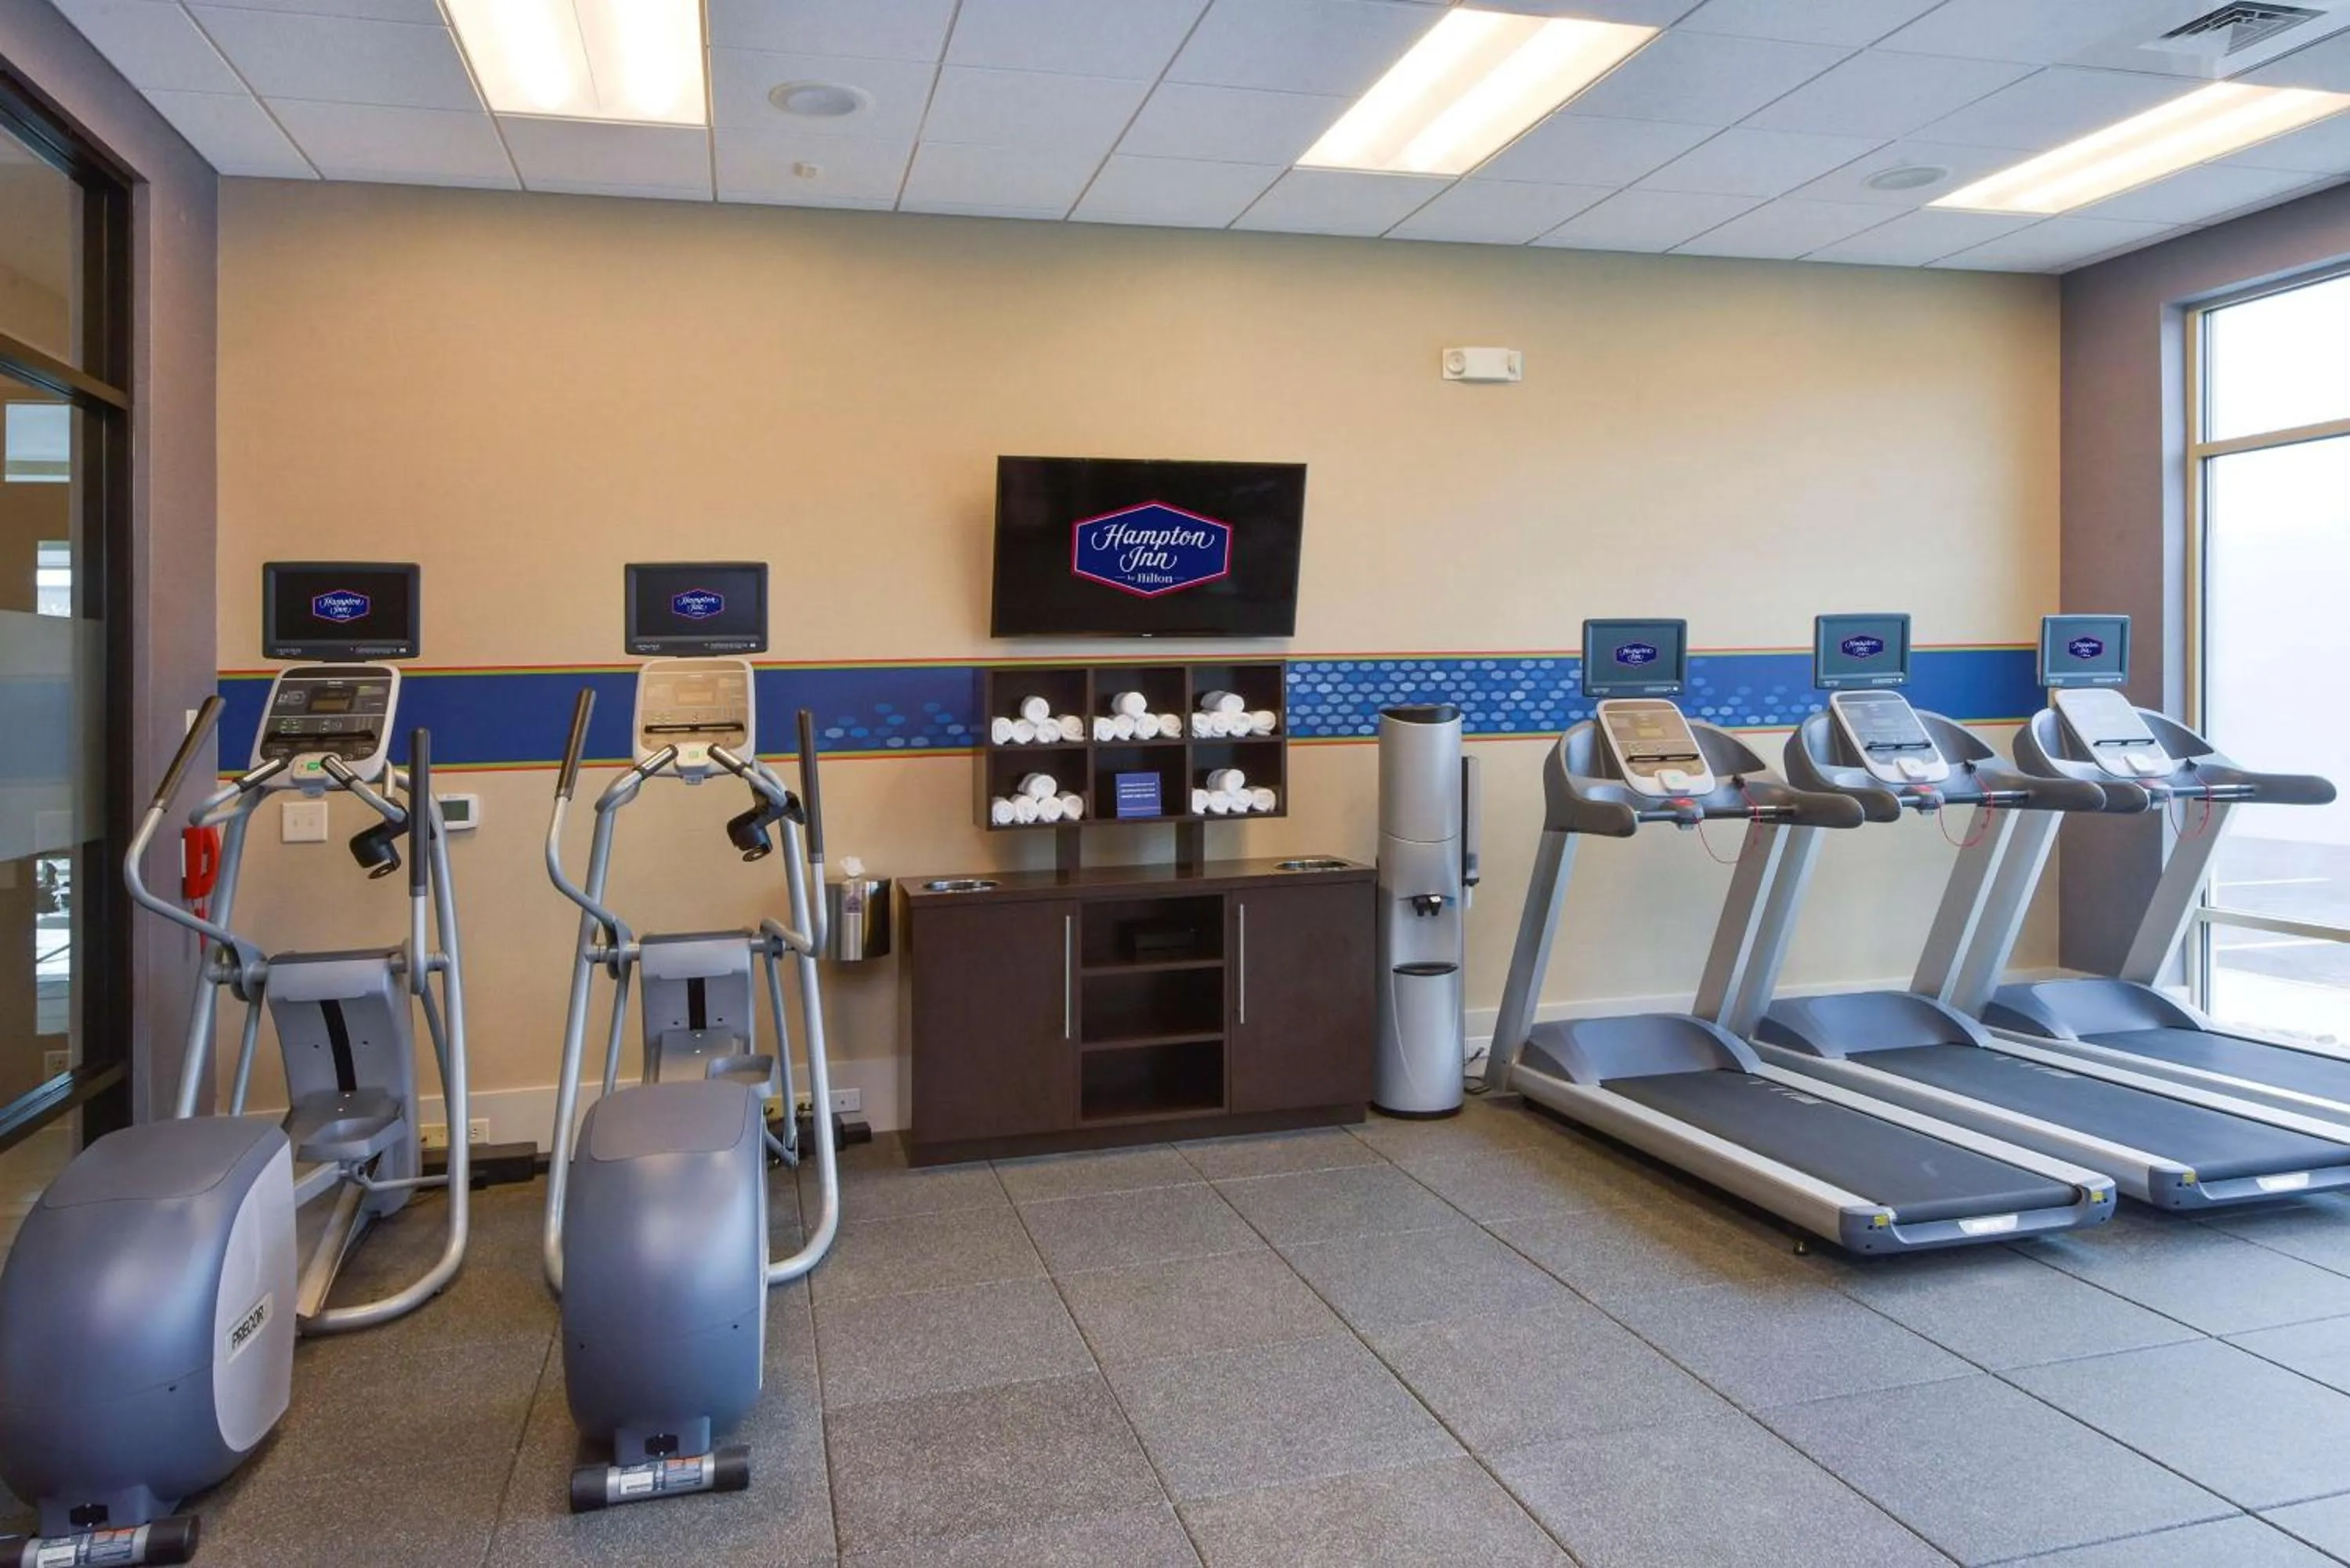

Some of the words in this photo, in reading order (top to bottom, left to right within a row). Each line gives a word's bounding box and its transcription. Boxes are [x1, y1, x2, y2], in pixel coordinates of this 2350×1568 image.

[1091, 522, 1215, 551] Hampton
[1119, 546, 1177, 573] Inn
[1137, 573, 1173, 583] Hilton
[231, 1305, 264, 1350] PRECOR
